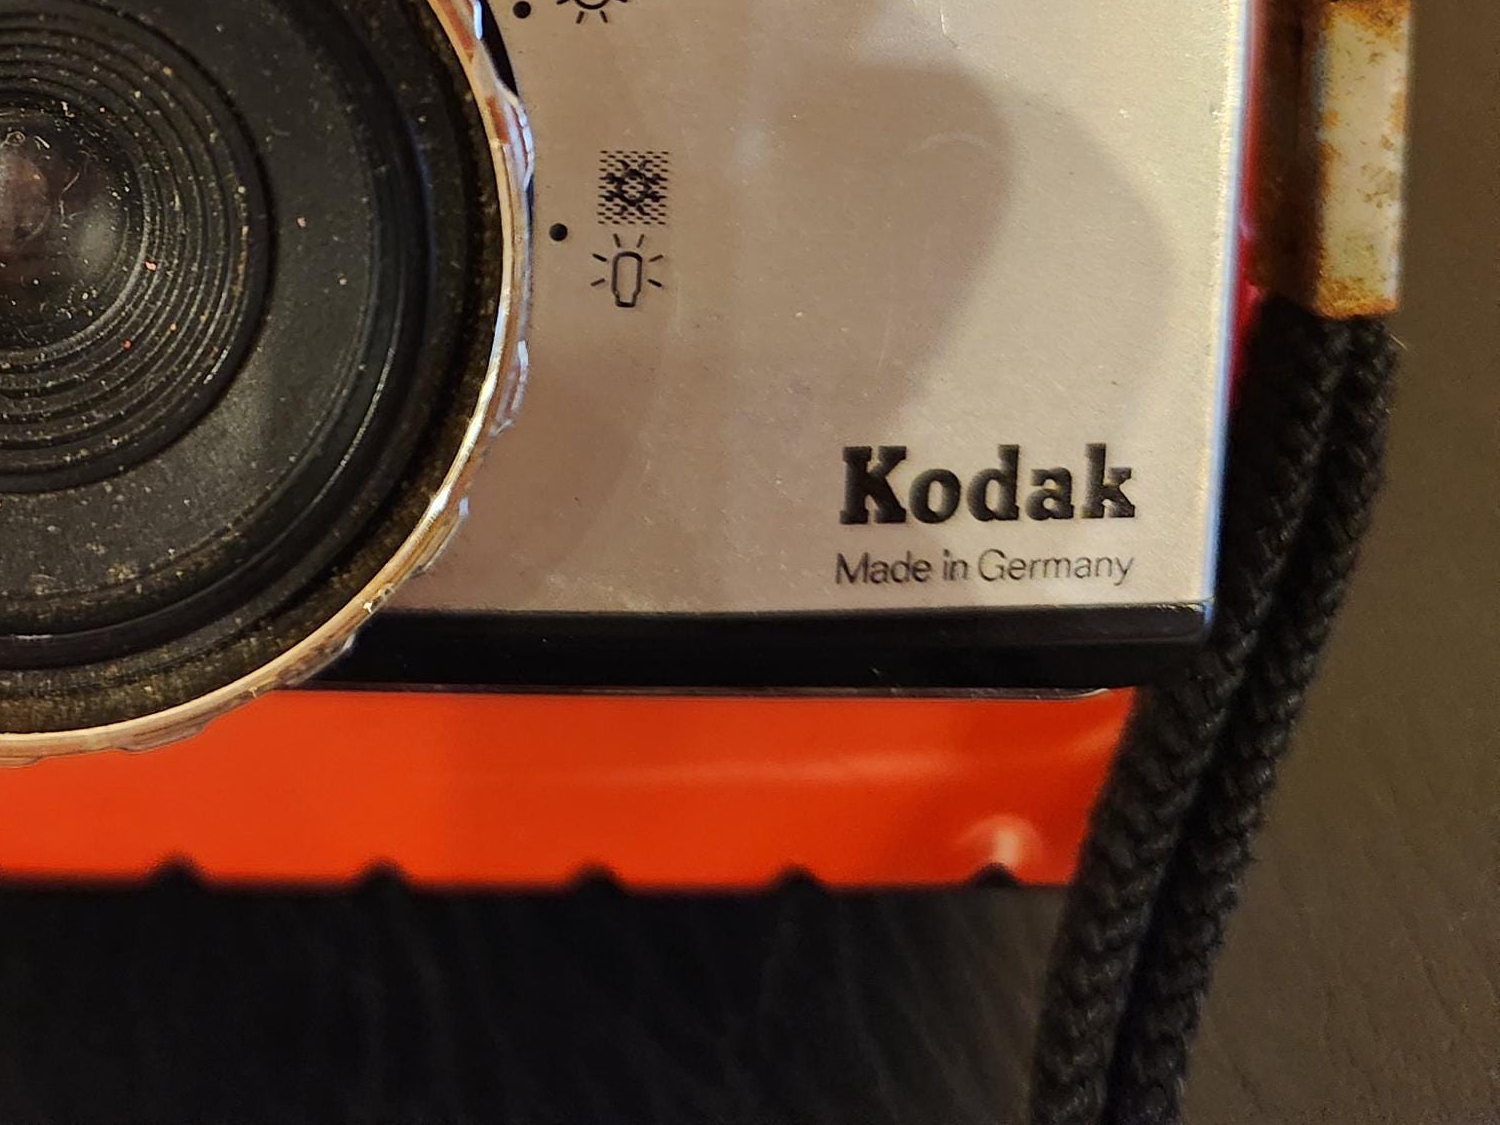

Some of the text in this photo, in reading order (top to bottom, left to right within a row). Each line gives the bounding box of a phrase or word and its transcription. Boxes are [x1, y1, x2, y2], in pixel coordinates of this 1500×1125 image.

[838, 442, 1136, 525] Kodak
[834, 548, 1135, 586] Made in Germany
